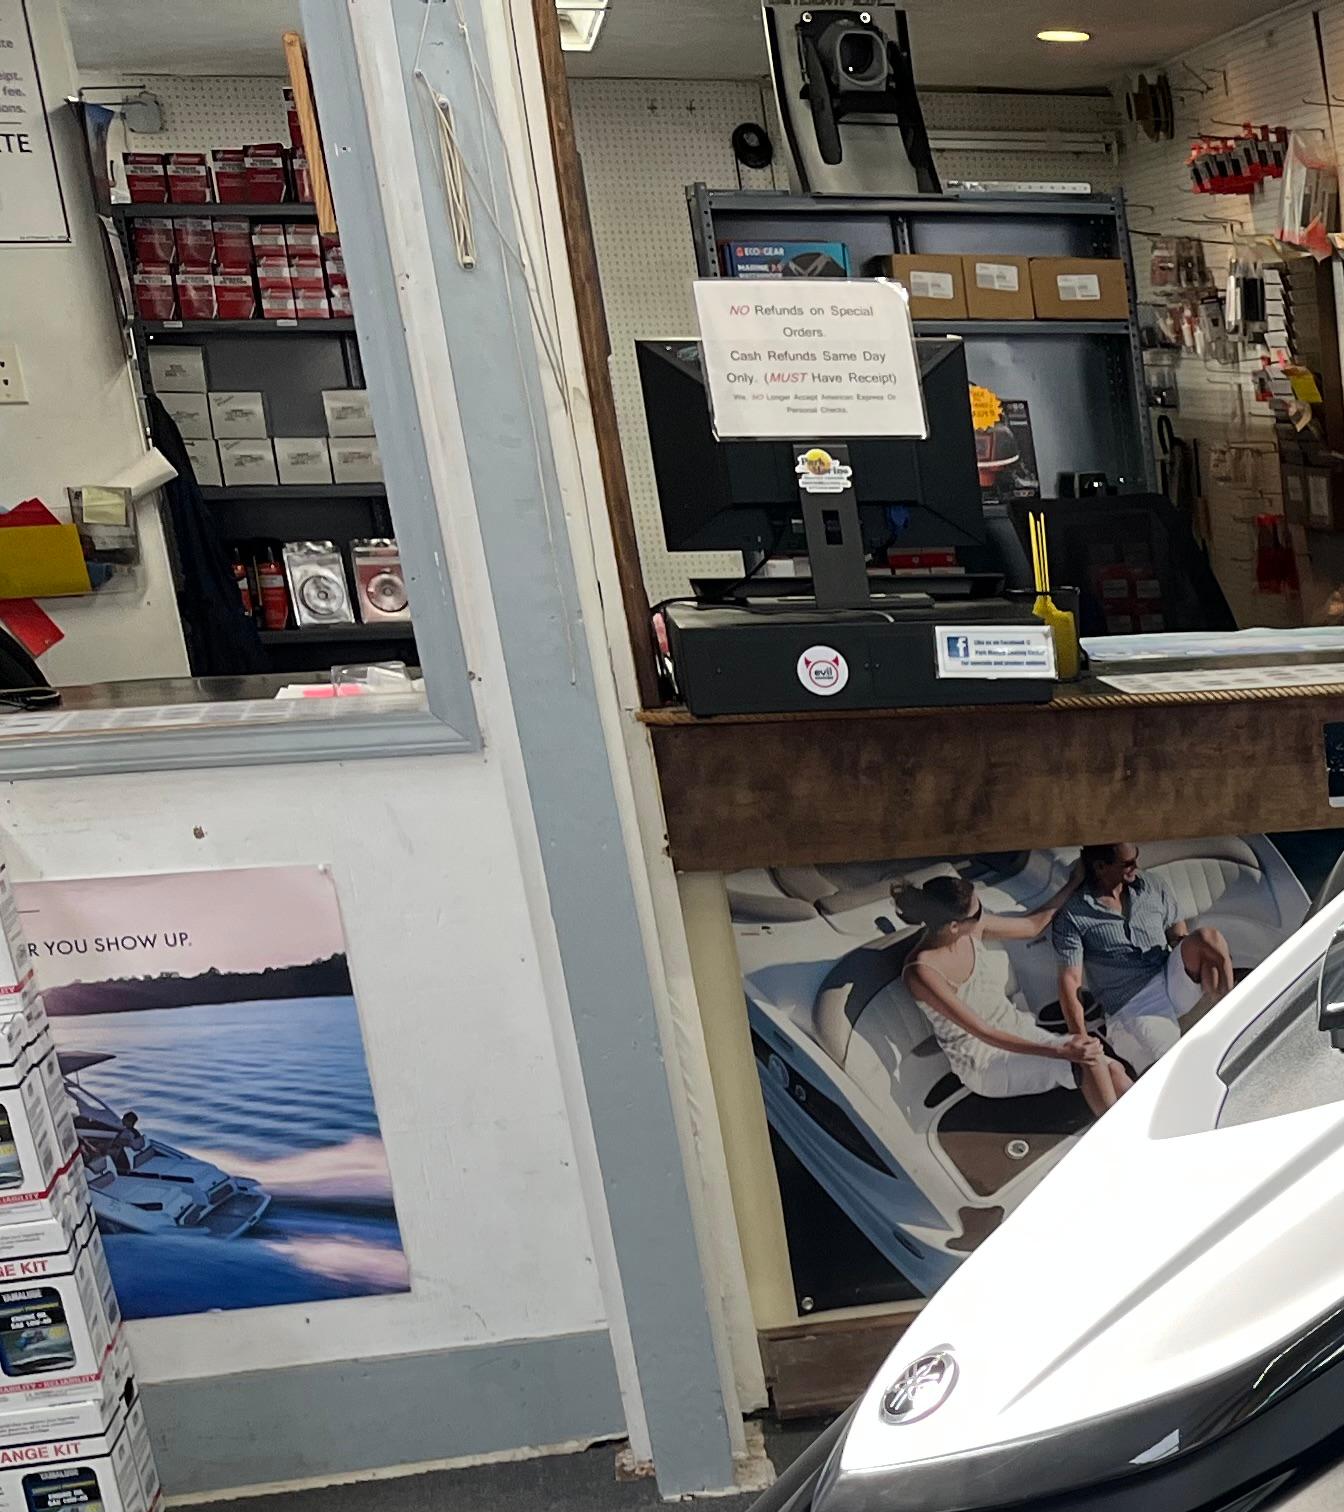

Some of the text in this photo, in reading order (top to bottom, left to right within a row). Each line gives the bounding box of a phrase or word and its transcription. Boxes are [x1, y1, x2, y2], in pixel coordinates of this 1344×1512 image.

[729, 304, 874, 318] NO Refunds on Special
[782, 326, 827, 338] Orders.
[730, 350, 886, 363] Cash Refunds Same Day
[726, 372, 897, 385] Only. (MUST Have Receipt)
[44, 938, 88, 956] YOU
[94, 933, 158, 953] SHOW
[164, 931, 192, 948] UP.
[20, 1260, 48, 1275] KIT
[44, 1374, 97, 1389] RELIABILITY
[54, 1441, 82, 1457] KIT
